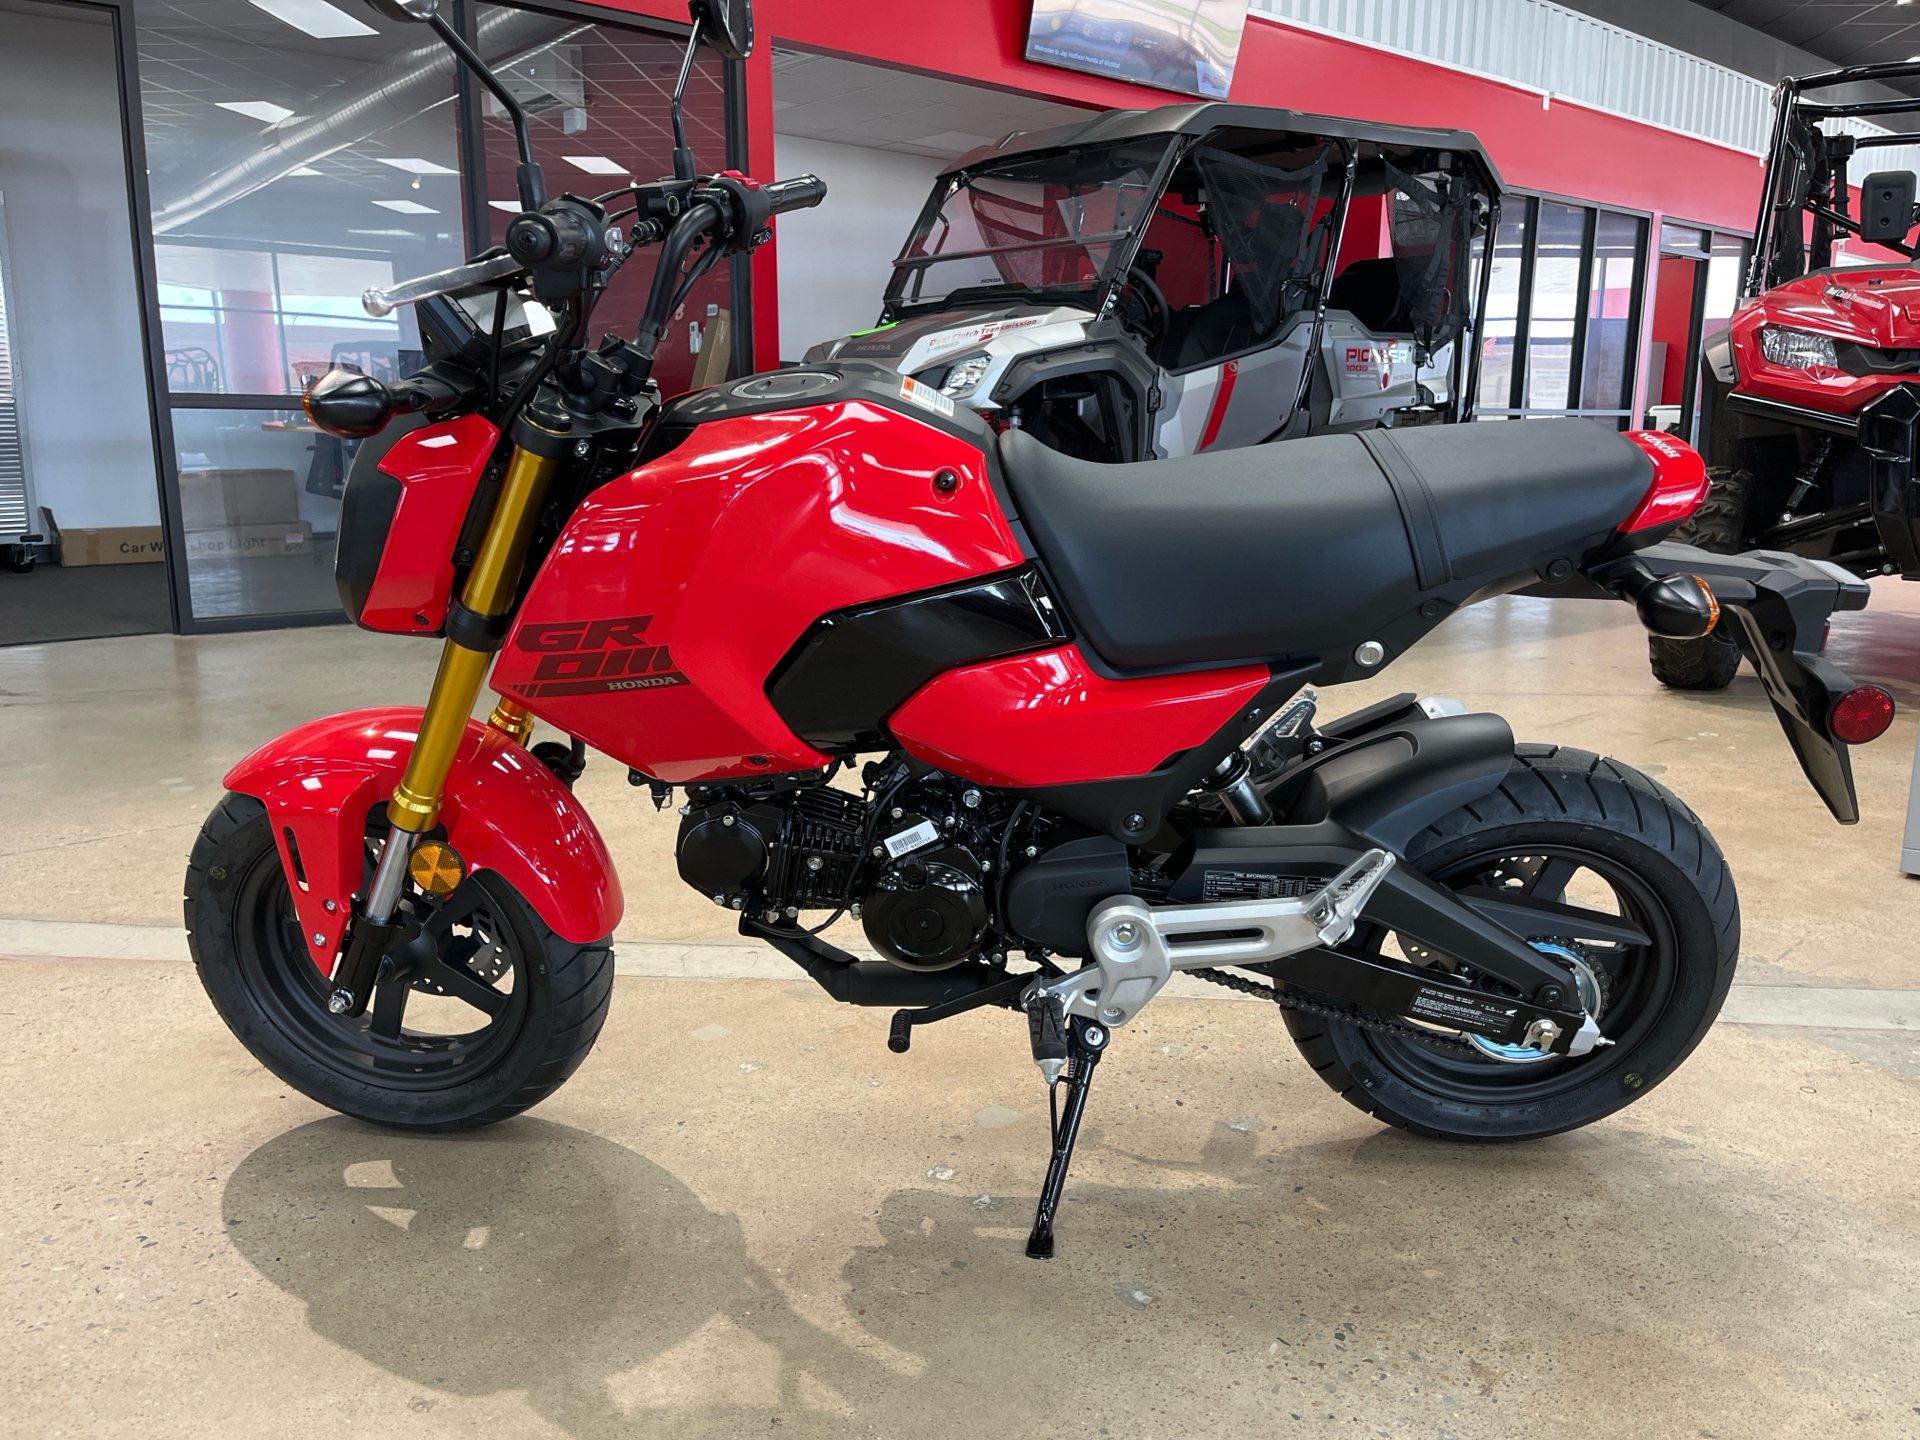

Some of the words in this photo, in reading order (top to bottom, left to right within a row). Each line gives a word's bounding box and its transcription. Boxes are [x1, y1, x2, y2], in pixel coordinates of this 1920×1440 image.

[980, 318, 1038, 335] Transmission
[855, 344, 891, 352] HONDA
[1393, 373, 1413, 381] HONDA
[1638, 432, 1681, 458] HONDA
[119, 541, 147, 553] Car
[229, 537, 266, 551] Light
[607, 676, 680, 691] HONDA
[1051, 879, 1109, 891] HONDA
